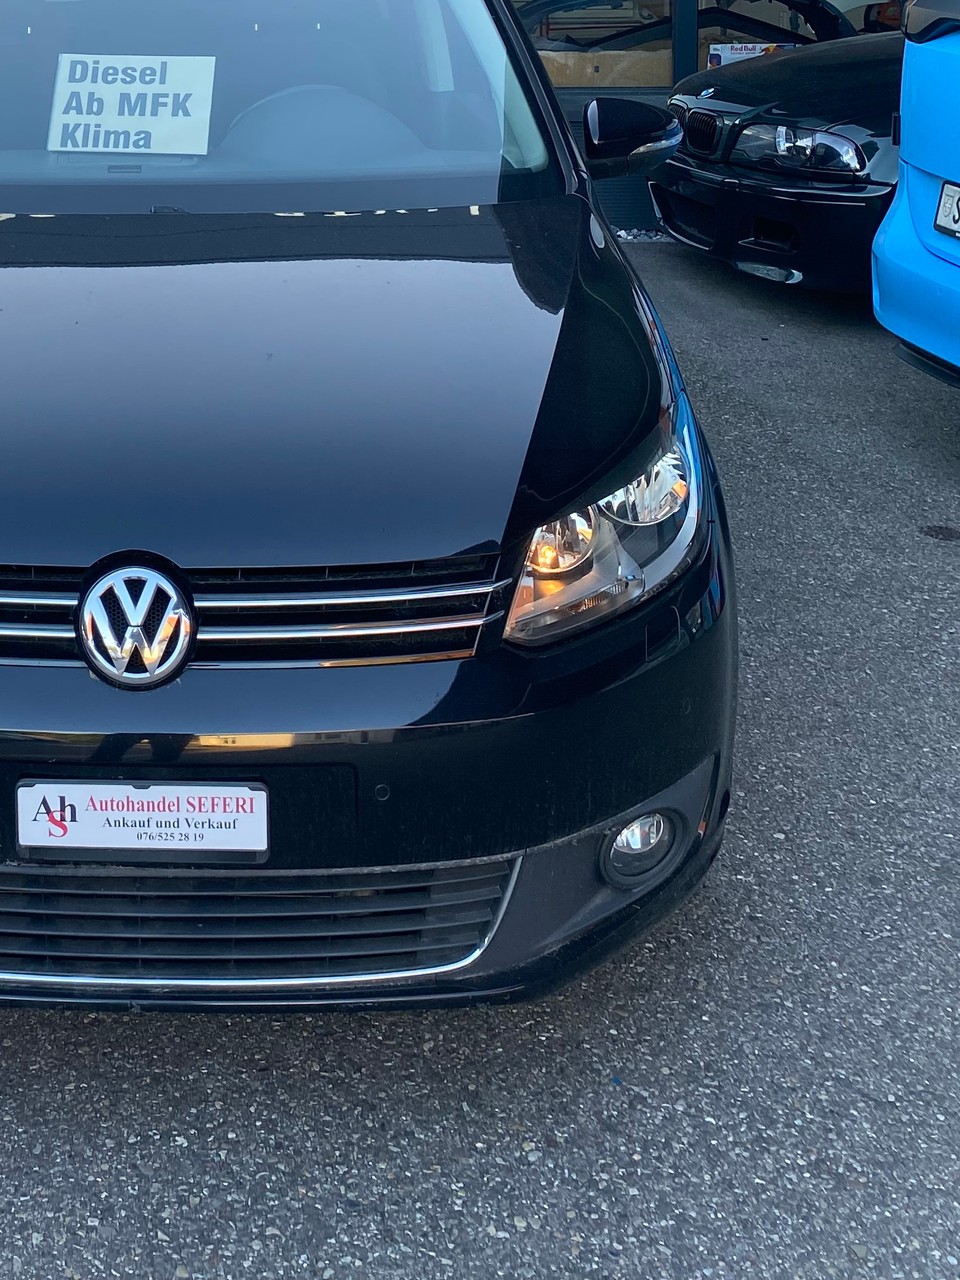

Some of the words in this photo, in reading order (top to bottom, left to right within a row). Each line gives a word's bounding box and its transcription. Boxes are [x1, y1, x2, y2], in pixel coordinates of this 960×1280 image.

[67, 60, 168, 85] Diesel
[62, 91, 104, 116] Ab
[117, 93, 193, 117] MFK
[60, 123, 153, 149] Klima
[85, 795, 180, 813] Autohandel
[186, 796, 256, 814] SEFERI
[102, 816, 152, 829] Ankauf
[155, 817, 181, 829] und
[183, 817, 239, 830] Verkauf
[136, 831, 176, 842] 076/525
[178, 832, 190, 842] 28
[192, 832, 205, 842] 19
